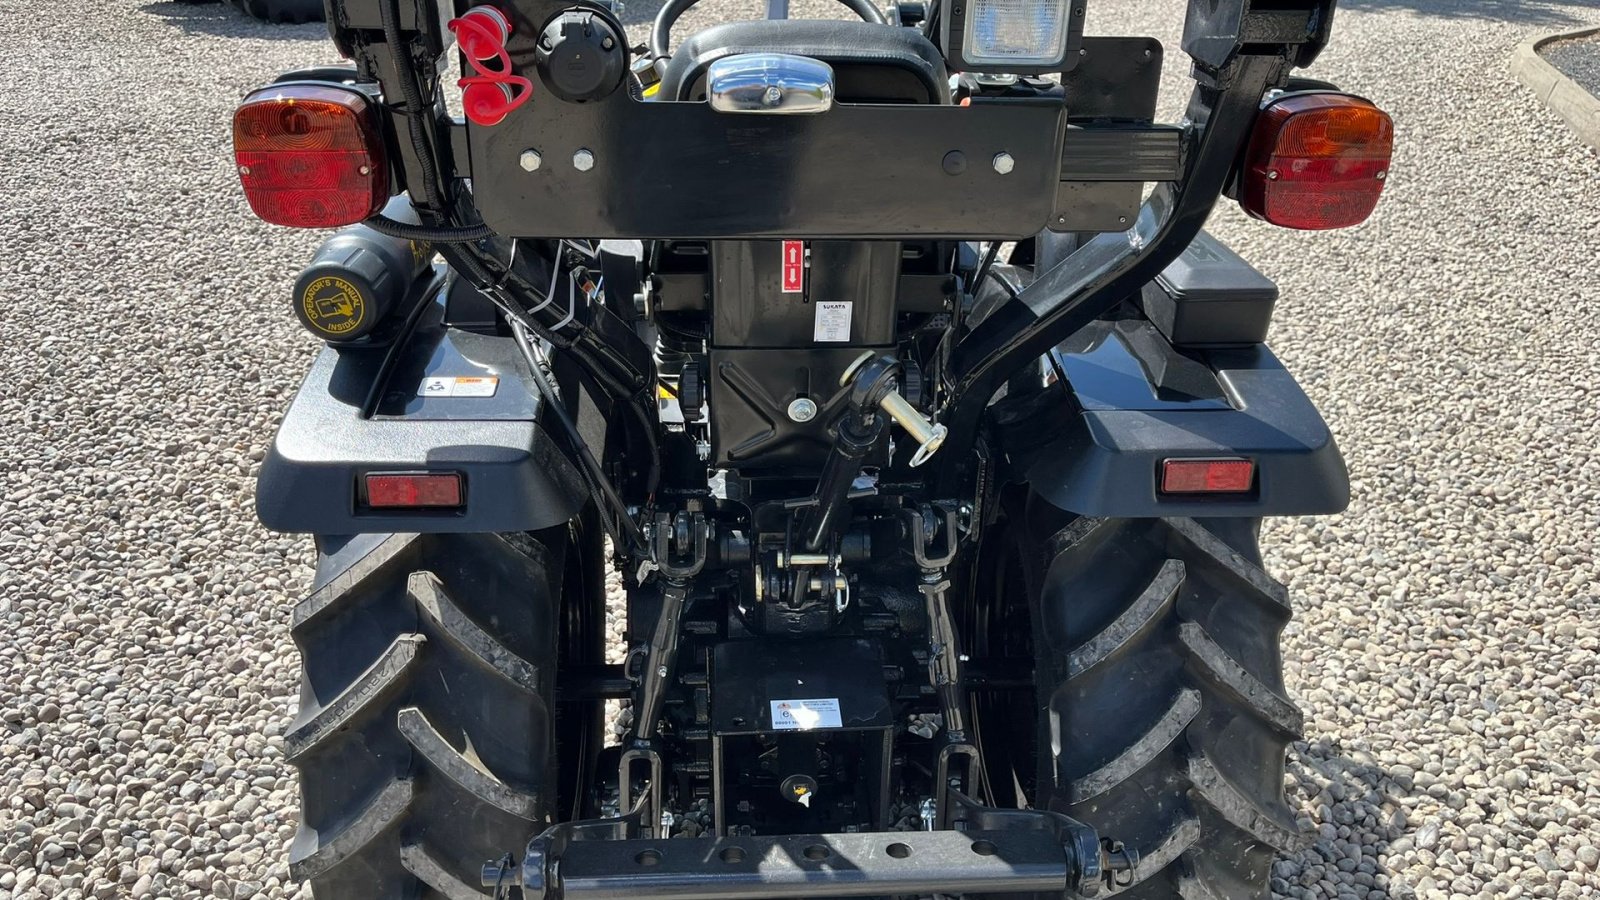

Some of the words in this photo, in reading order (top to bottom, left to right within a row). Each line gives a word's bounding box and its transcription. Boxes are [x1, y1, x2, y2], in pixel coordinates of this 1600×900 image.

[306, 279, 331, 319] OPERATOR'S
[335, 280, 360, 308] MANUAL
[328, 318, 356, 331] INSIDE
